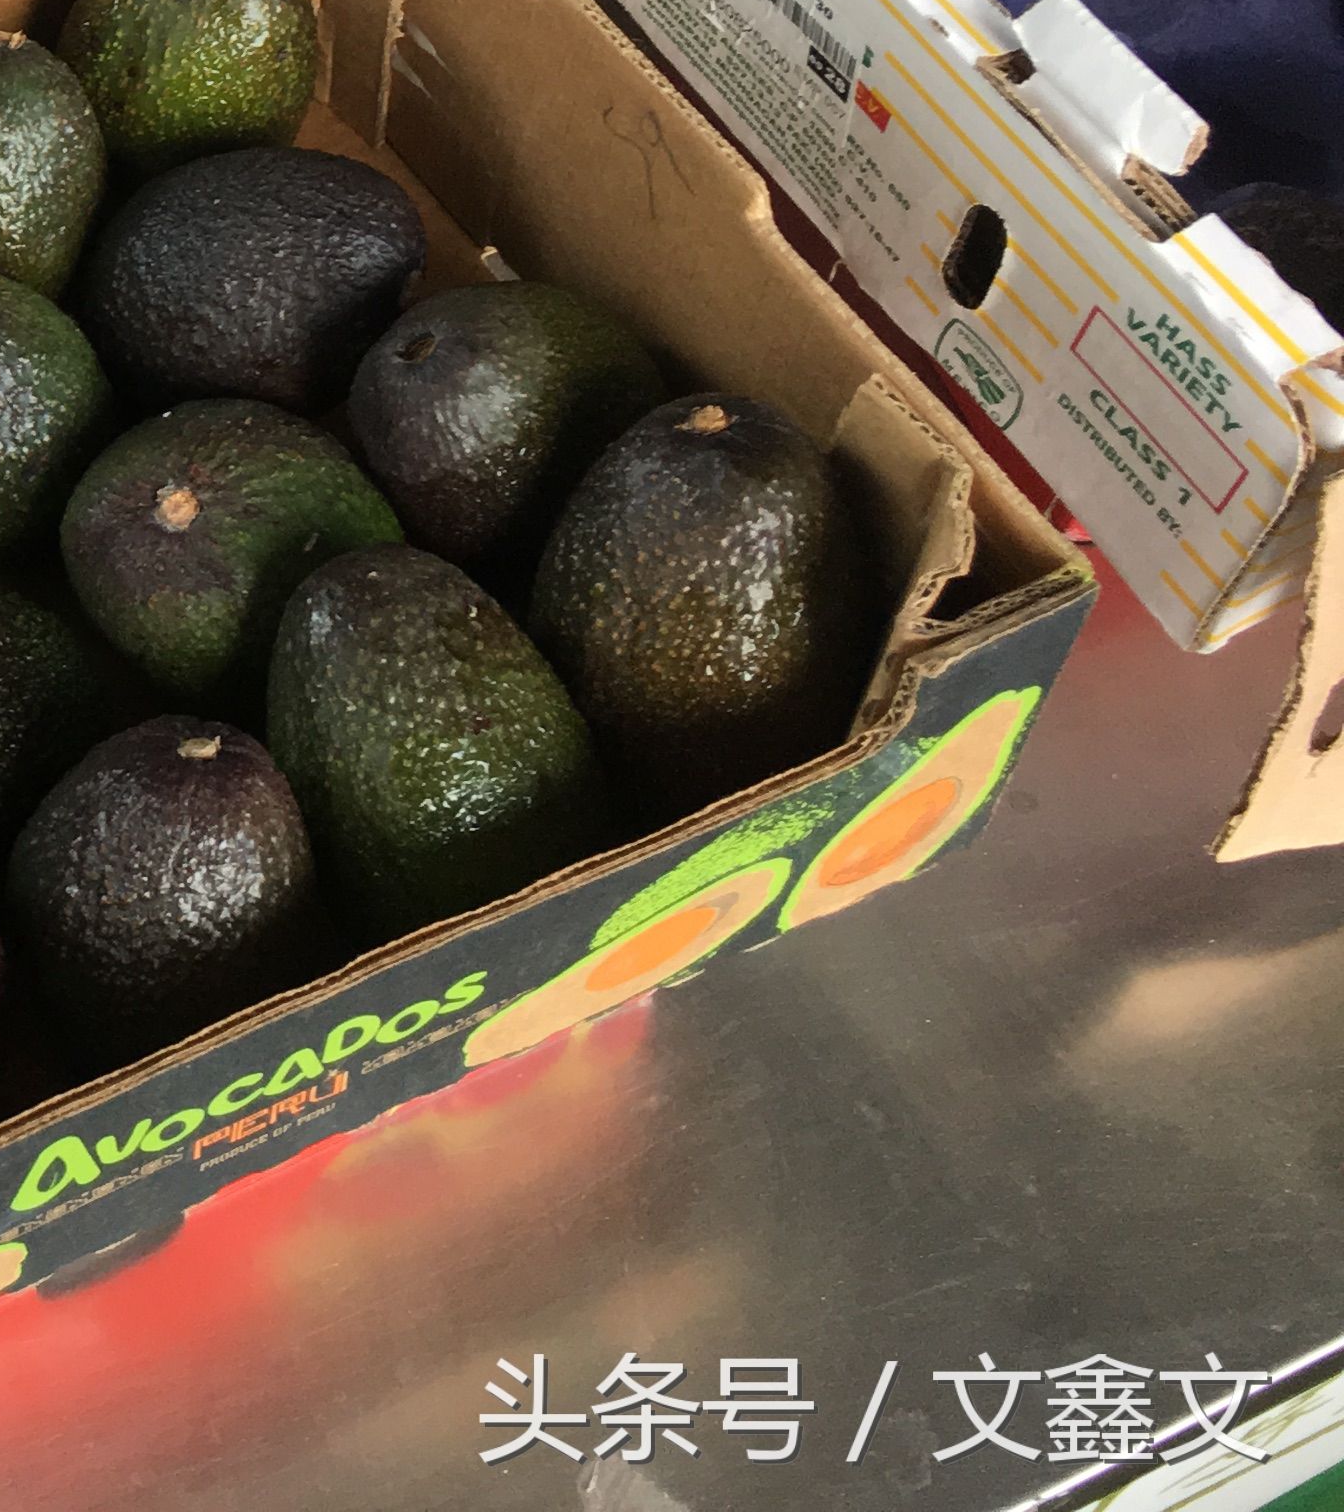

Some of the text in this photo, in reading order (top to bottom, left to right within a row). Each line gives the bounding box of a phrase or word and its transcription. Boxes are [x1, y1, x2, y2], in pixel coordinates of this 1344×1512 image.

[1128, 308, 1242, 432] VARIETY
[1155, 314, 1232, 396] HASS
[1057, 393, 1156, 506] DISTRIBUTED
[1090, 389, 1172, 481] CLASS
[199, 1102, 337, 1173] PRODUCE OF PERU
